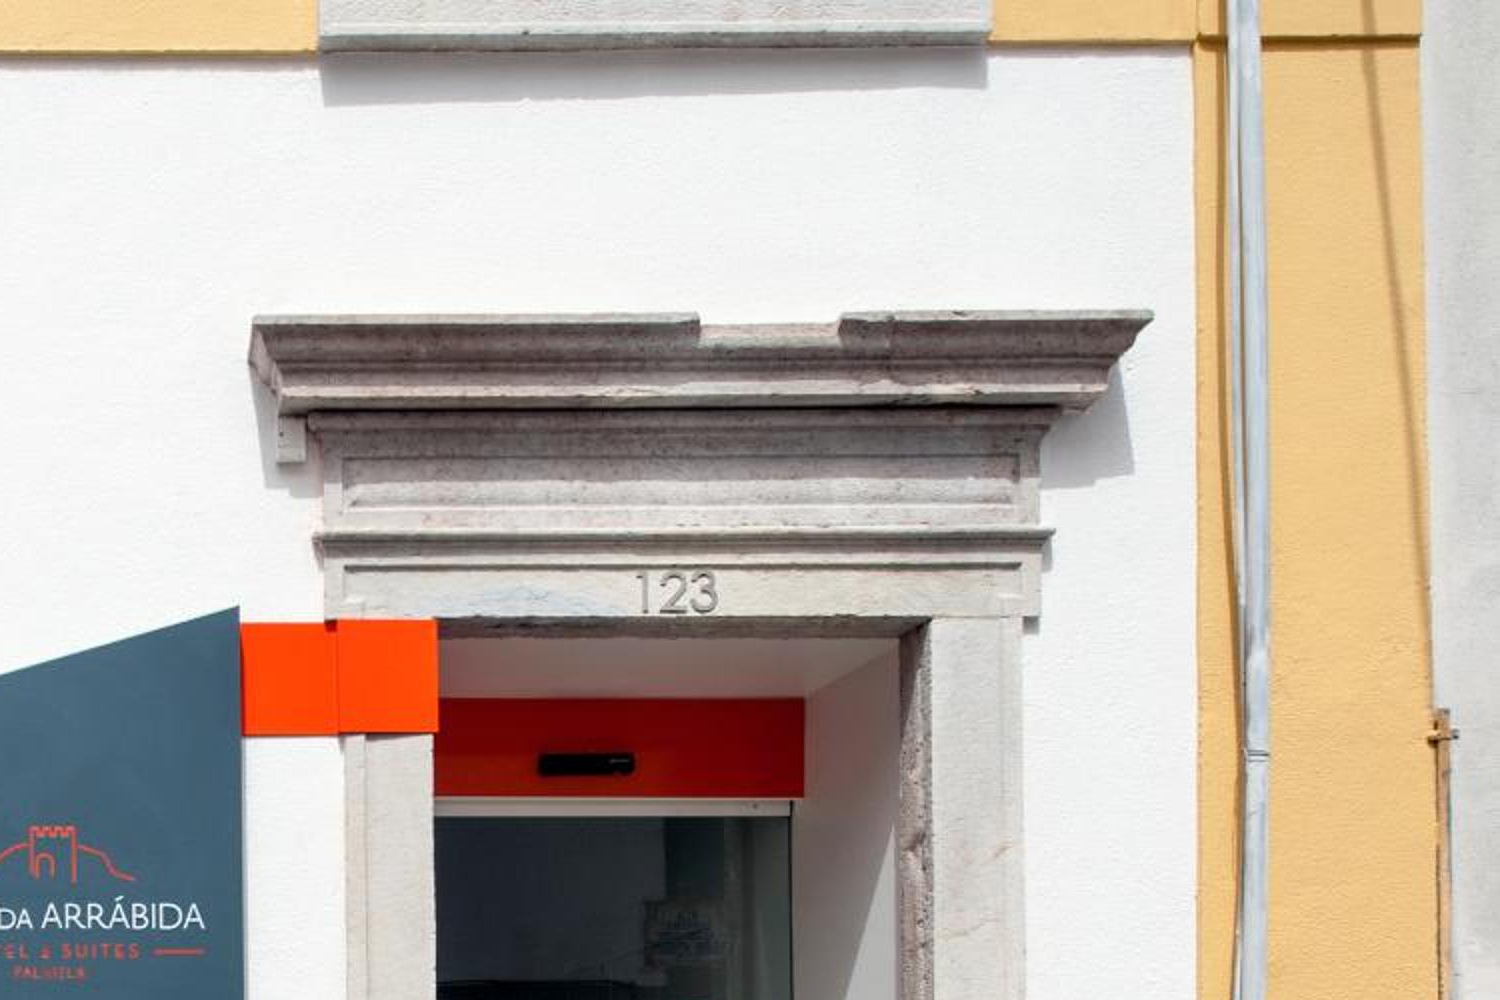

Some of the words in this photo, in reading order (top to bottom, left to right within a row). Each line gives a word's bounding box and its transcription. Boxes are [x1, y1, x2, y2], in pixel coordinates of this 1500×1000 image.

[635, 569, 719, 614] 123
[40, 895, 206, 931] ARRÁBIDA
[60, 943, 142, 961] SUITES
